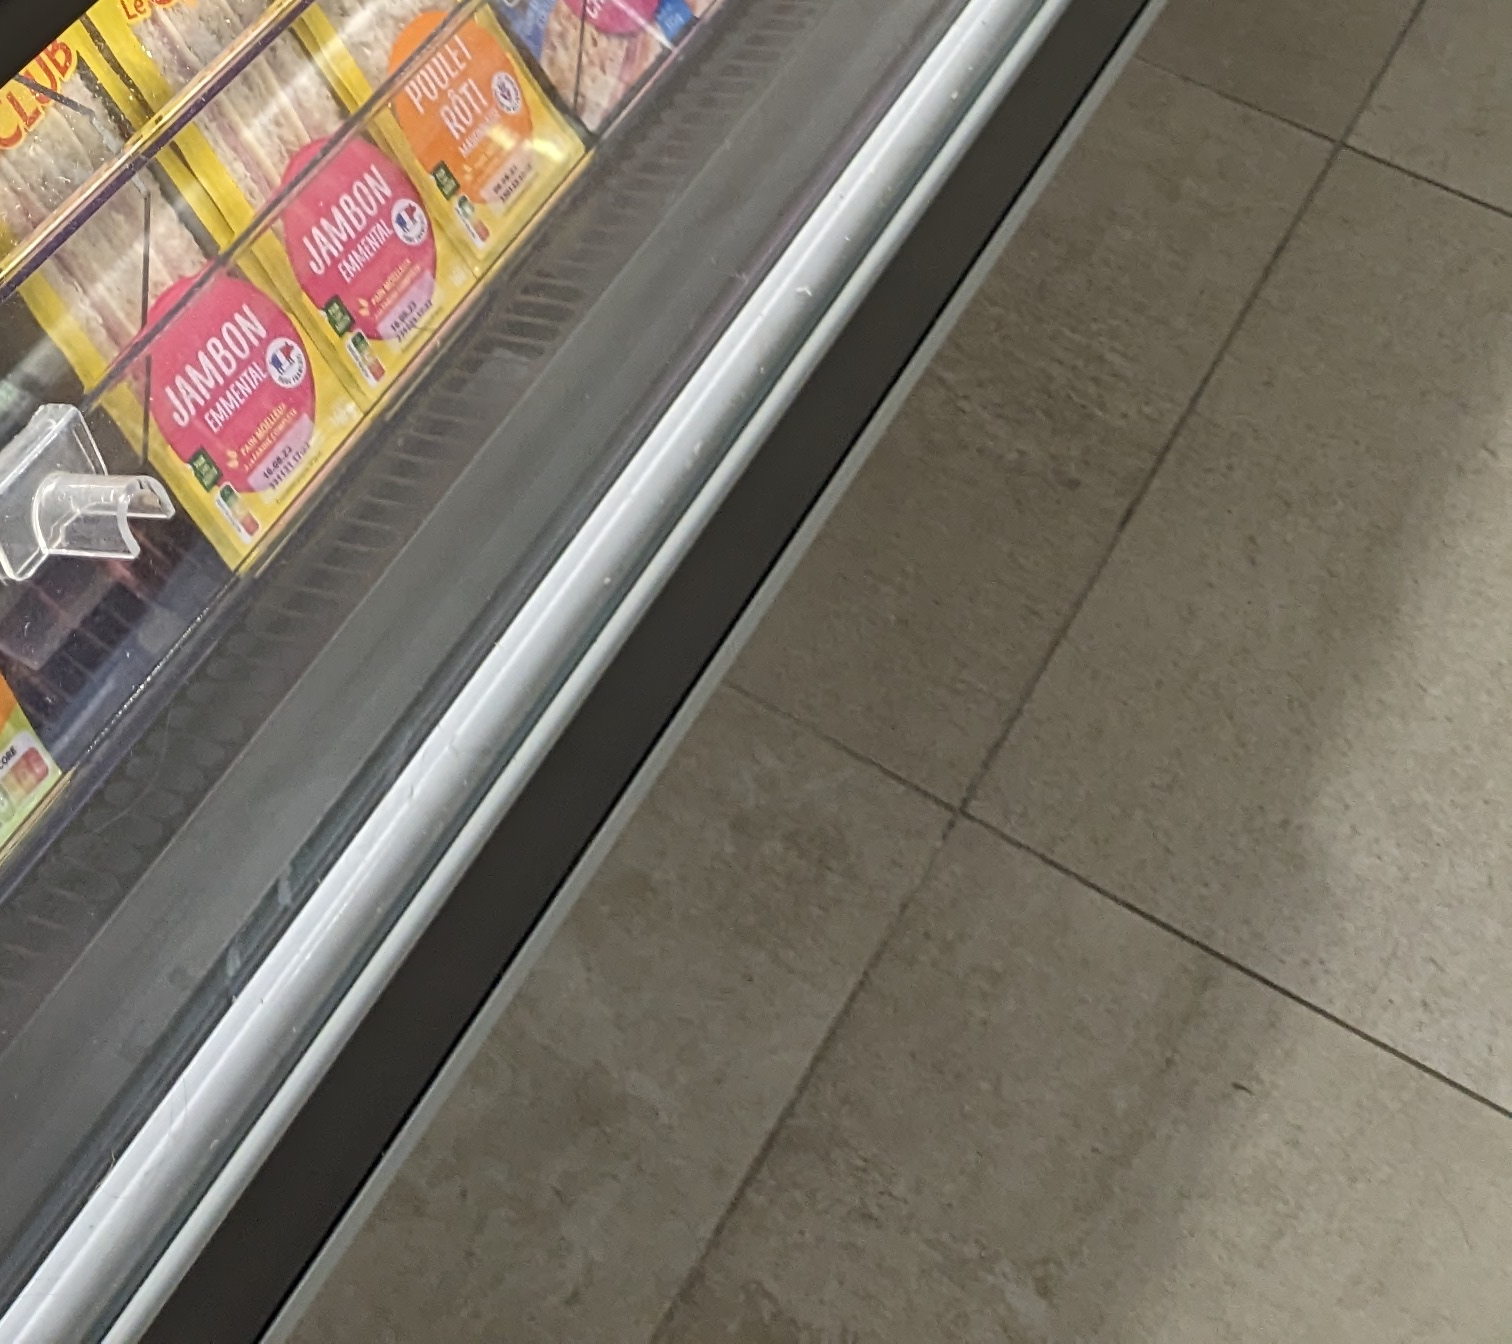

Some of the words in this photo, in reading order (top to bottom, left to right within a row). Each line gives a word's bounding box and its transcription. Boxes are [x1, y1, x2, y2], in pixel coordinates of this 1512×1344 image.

[406, 38, 474, 114] POULET
[438, 85, 490, 141] RÔTI
[306, 161, 395, 279] JAMBON
[337, 217, 394, 283] EMMENTAL
[167, 302, 270, 429] JAMBON
[203, 361, 269, 434] EMMENTAL
